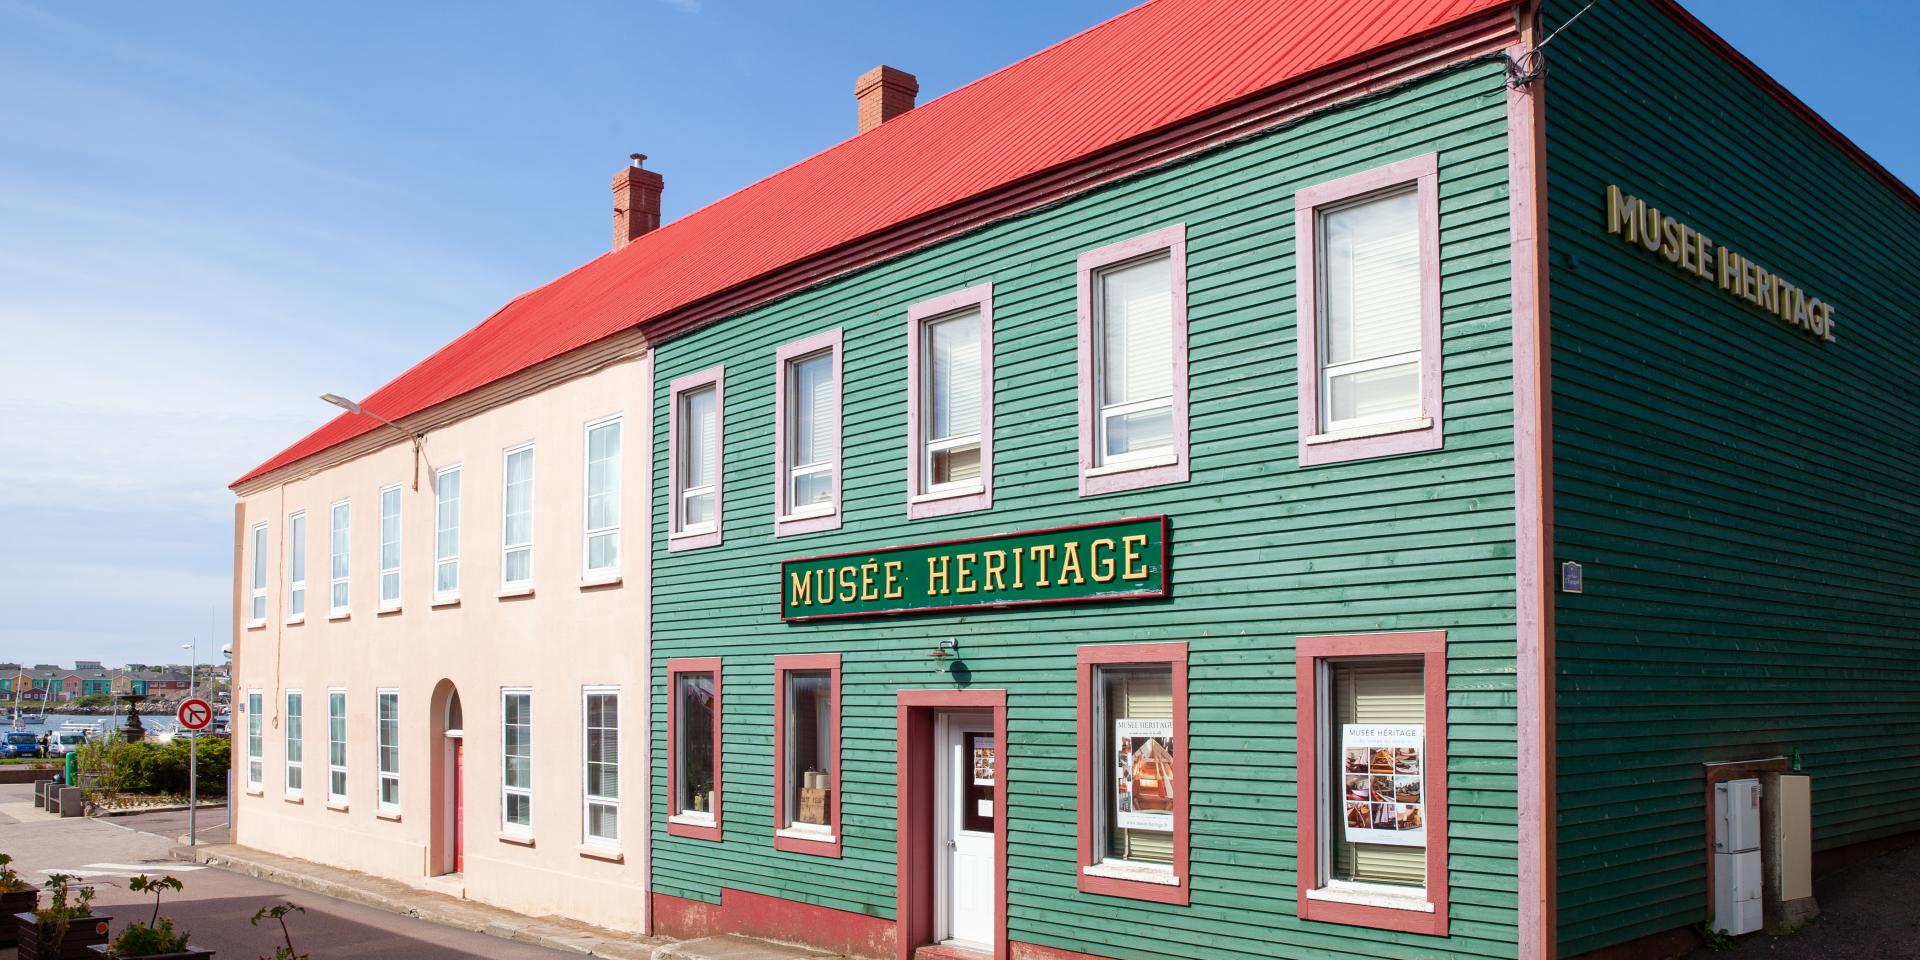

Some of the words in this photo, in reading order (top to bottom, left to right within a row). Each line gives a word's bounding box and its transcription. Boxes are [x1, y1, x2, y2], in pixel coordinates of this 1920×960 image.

[1606, 184, 1714, 282] MUSEE
[1717, 246, 1836, 343] HERITAGE
[791, 557, 903, 606] MUSÉE
[927, 534, 1149, 596] HERITAGE
